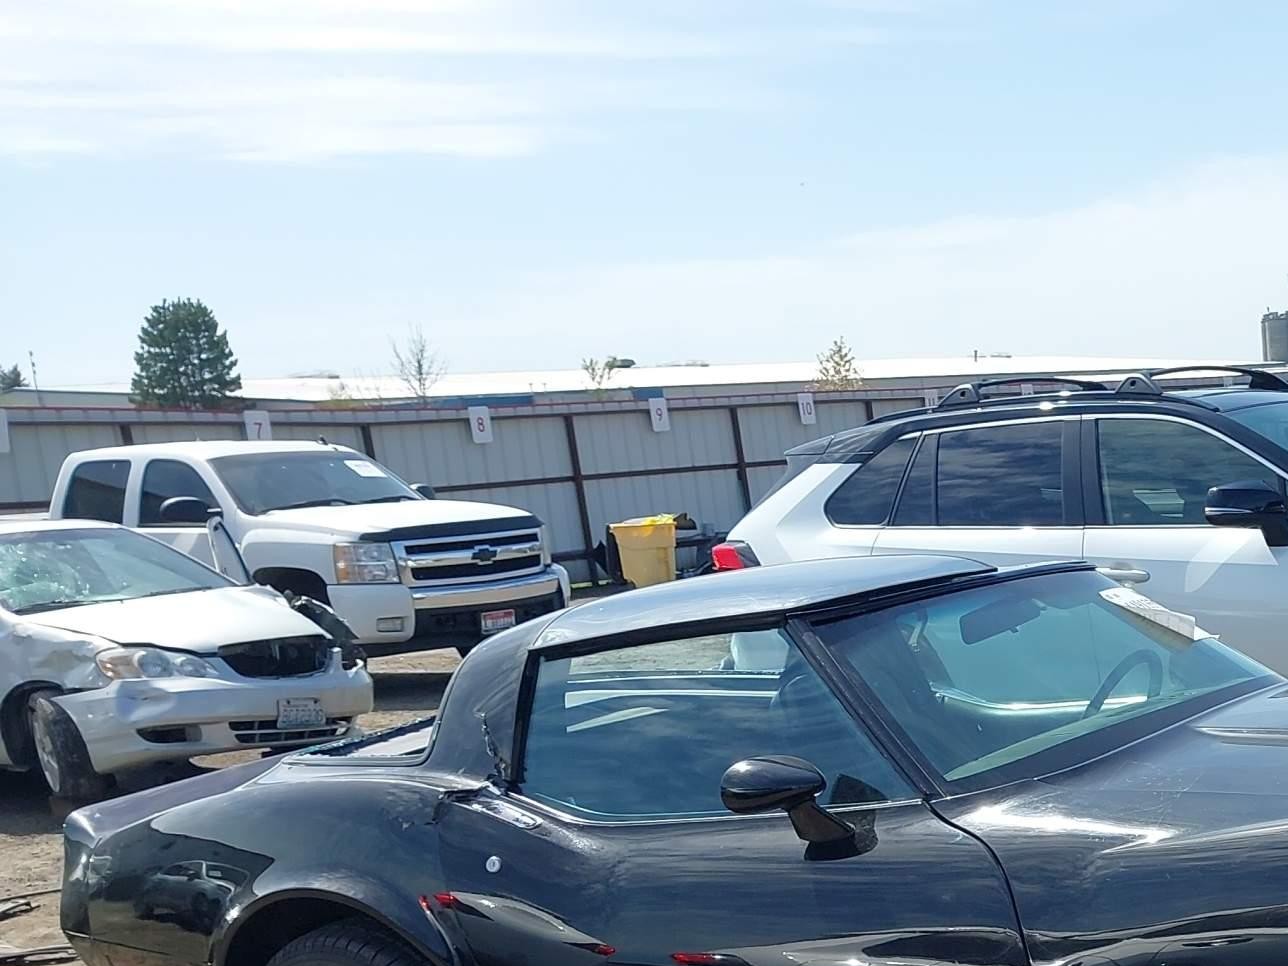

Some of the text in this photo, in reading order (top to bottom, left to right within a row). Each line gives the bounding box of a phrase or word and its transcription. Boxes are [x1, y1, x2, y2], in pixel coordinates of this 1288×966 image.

[655, 407, 663, 421] 9
[801, 401, 813, 416] 10
[253, 421, 263, 440] 7
[476, 416, 485, 432] 8
